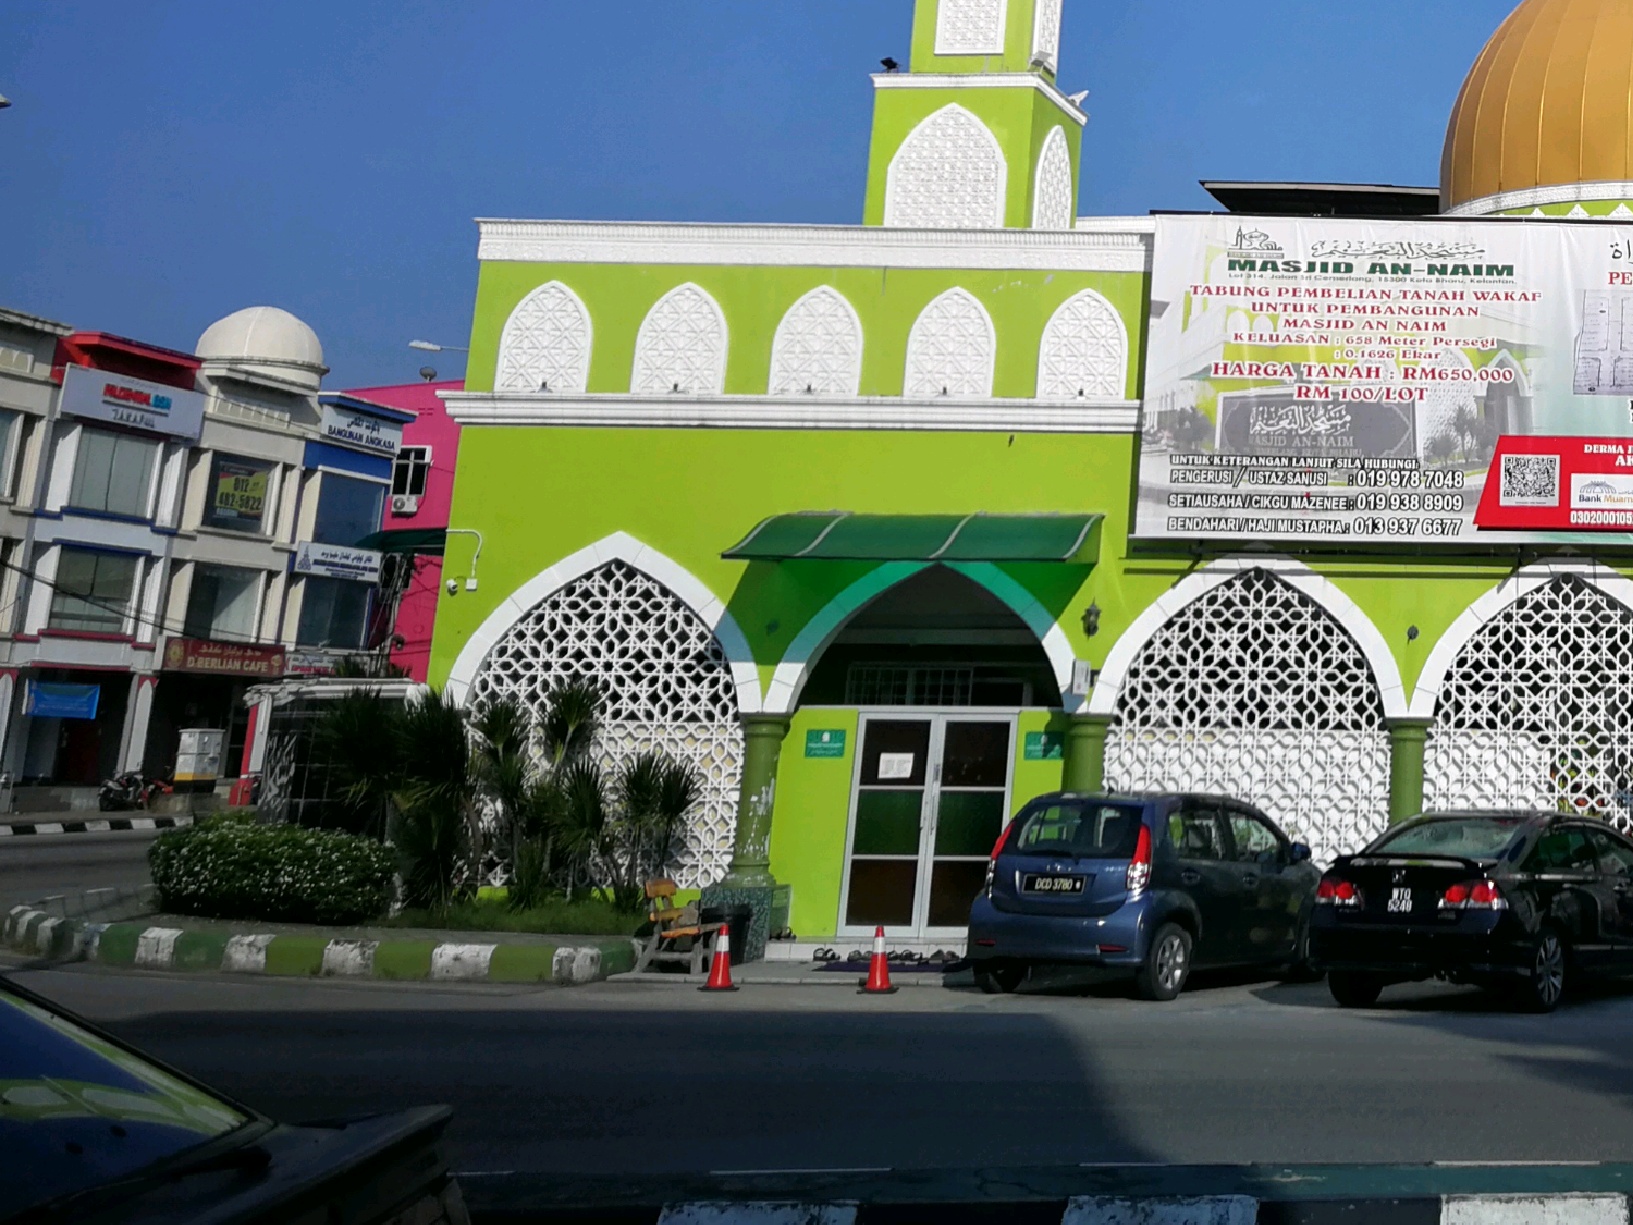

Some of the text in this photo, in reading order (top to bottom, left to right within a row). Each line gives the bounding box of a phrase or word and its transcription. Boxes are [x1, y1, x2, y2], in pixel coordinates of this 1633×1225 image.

[1228, 259, 1514, 276] MASJID AN-NAIM
[1190, 285, 1542, 302] TABUNG PEMBELIAN TANAH WAKAF
[1251, 302, 1479, 316] UNTUK PEMBANGUNAN
[1283, 318, 1447, 332] MASJID AN NAIM
[1233, 332, 1496, 348] KELUASAN 658 Meter Persegi
[1402, 349, 1441, 359] Ekar
[1212, 362, 1514, 382] HARGA TANAH RM650,000
[1297, 385, 1429, 401] RM 100/LOT
[1292, 436, 1354, 447] AN-NAIM
[1583, 444, 1624, 454] DERMA
[1171, 455, 1361, 469] UNTUK KETERANGAN LANJUT SILA
[1171, 469, 1464, 488] PENGERUSI USTAZ SANUSI 019 978 7048
[1168, 493, 1464, 512] SETIAUSAHA CIKGU MAZENEE 019 938 8909
[1579, 494, 1601, 503] Bank
[1167, 517, 1463, 535] BENDAHARI HAJI MUSTAPHA 013 937 6677
